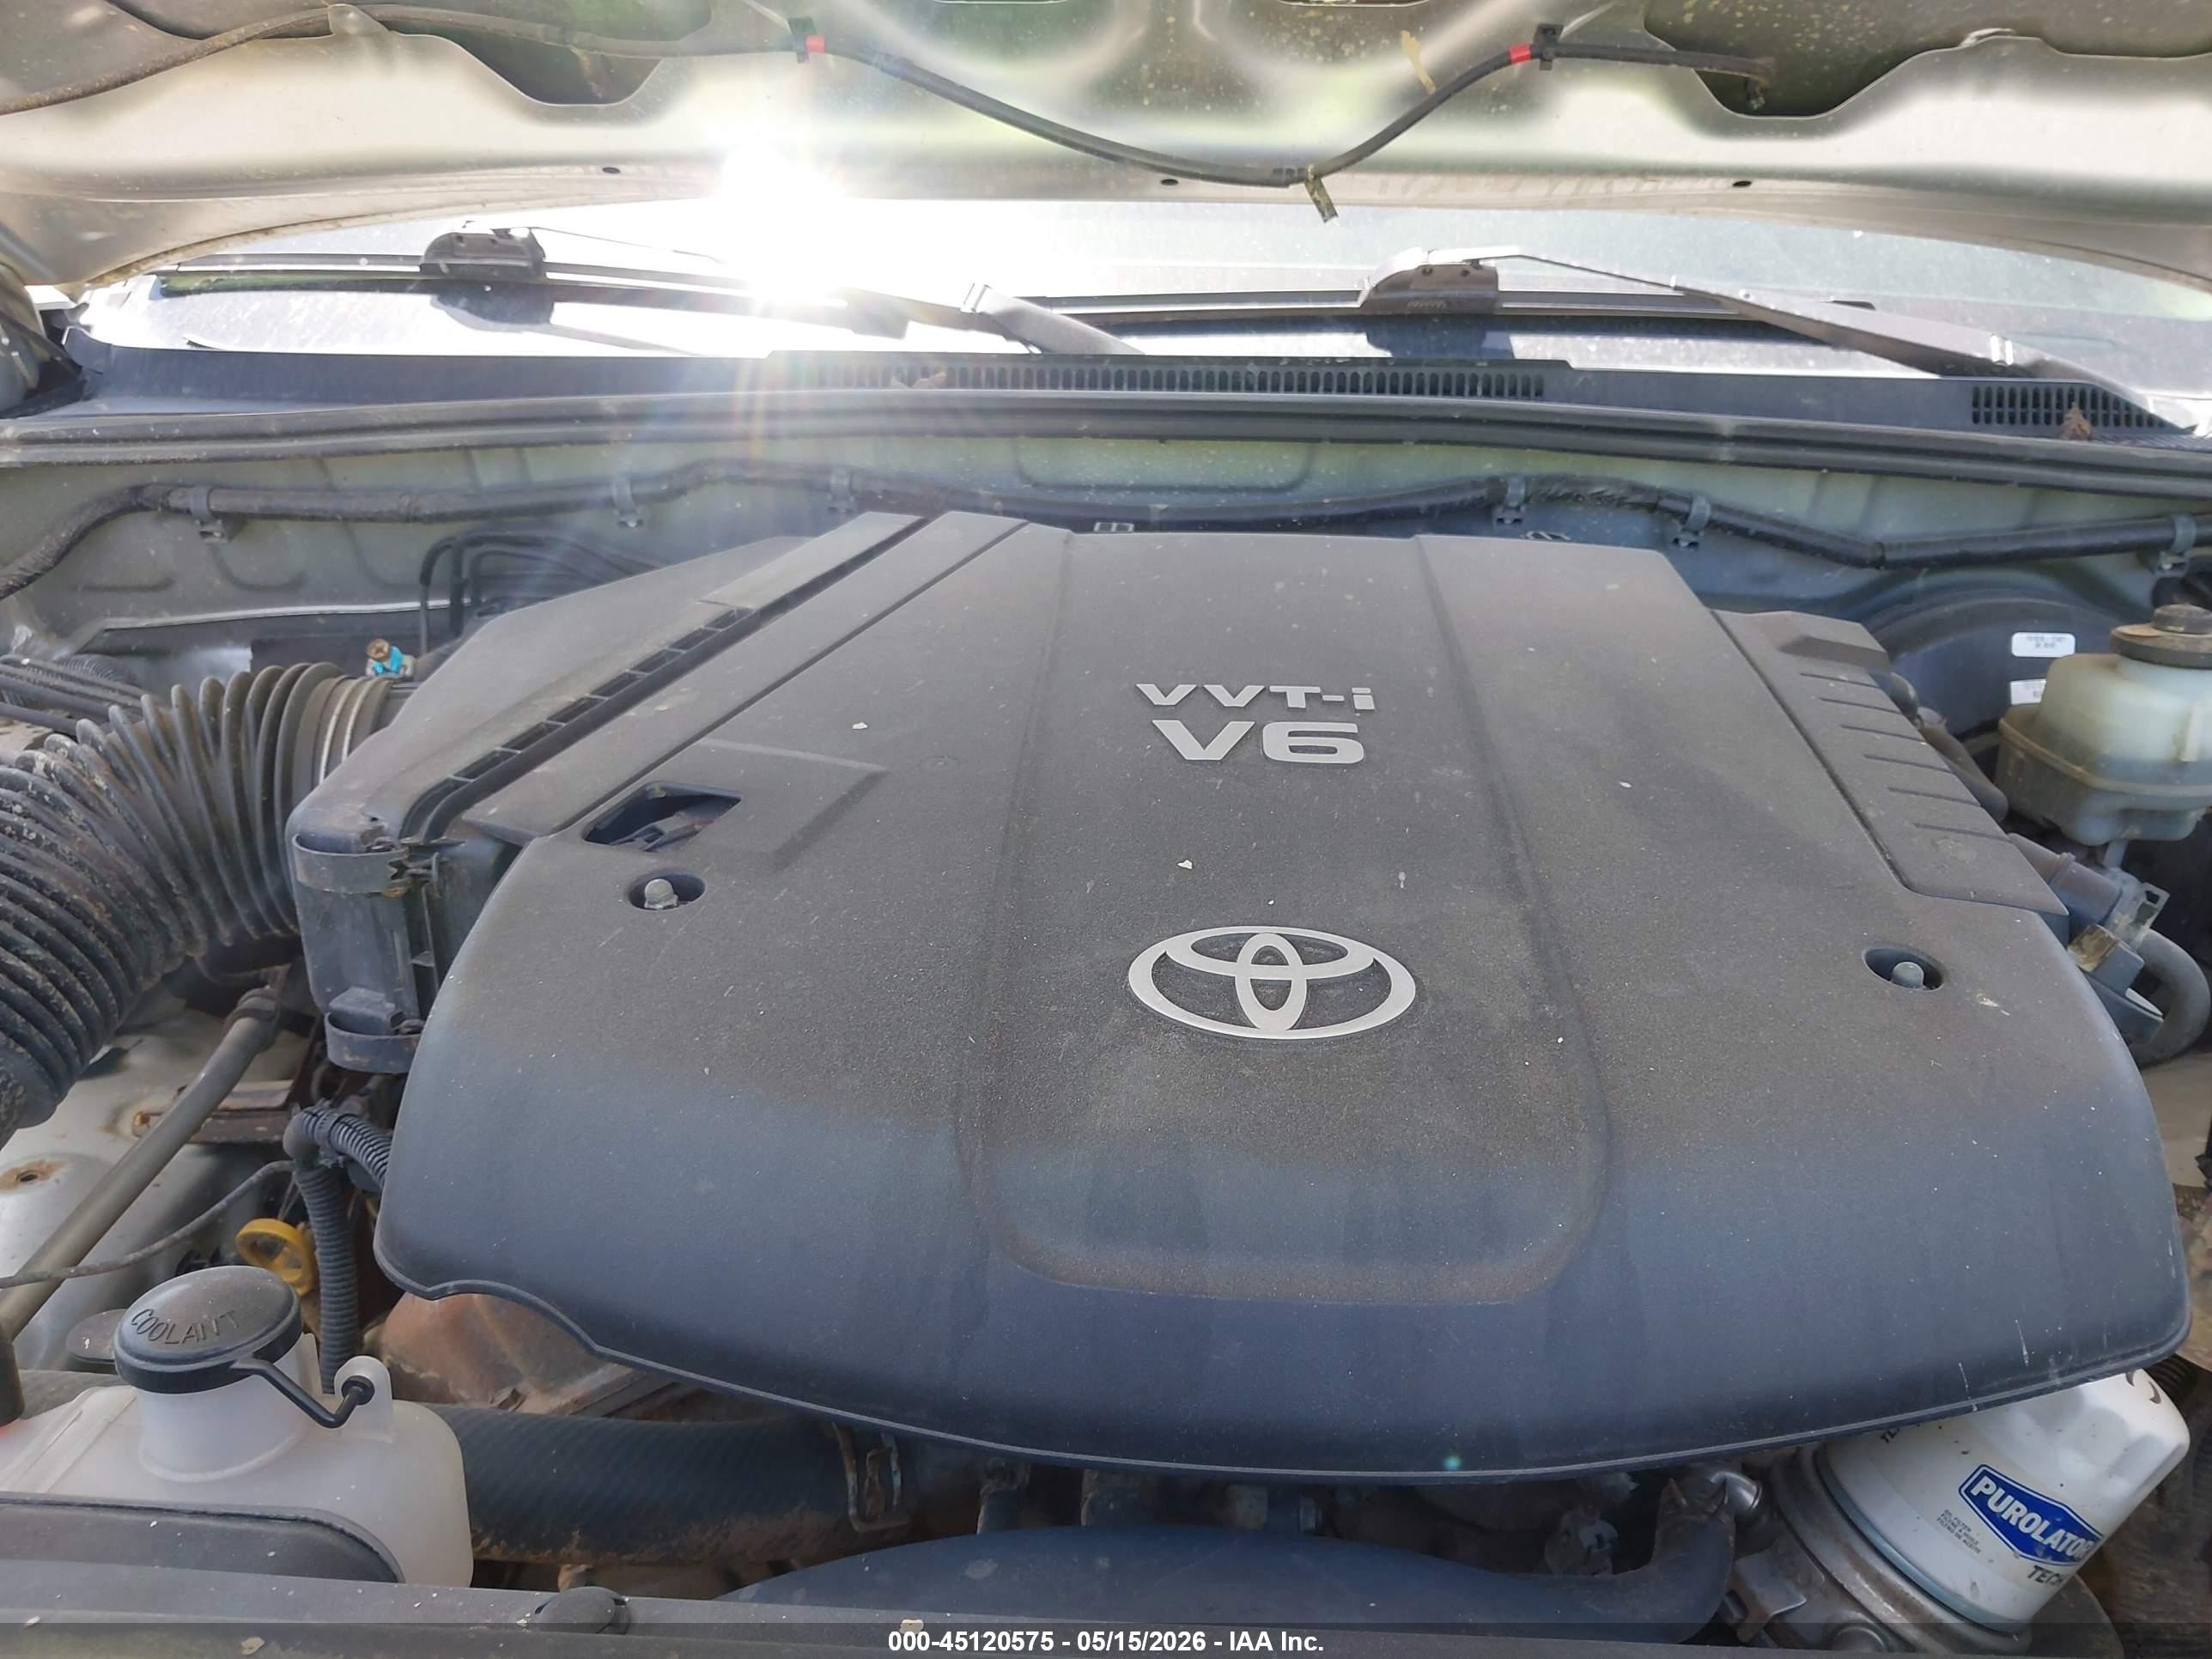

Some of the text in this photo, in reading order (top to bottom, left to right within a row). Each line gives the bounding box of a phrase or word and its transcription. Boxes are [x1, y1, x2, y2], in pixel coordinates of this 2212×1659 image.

[1135, 683, 1375, 710] VVT-i
[1152, 720, 1364, 764] V6
[131, 1309, 240, 1345] COOLANT
